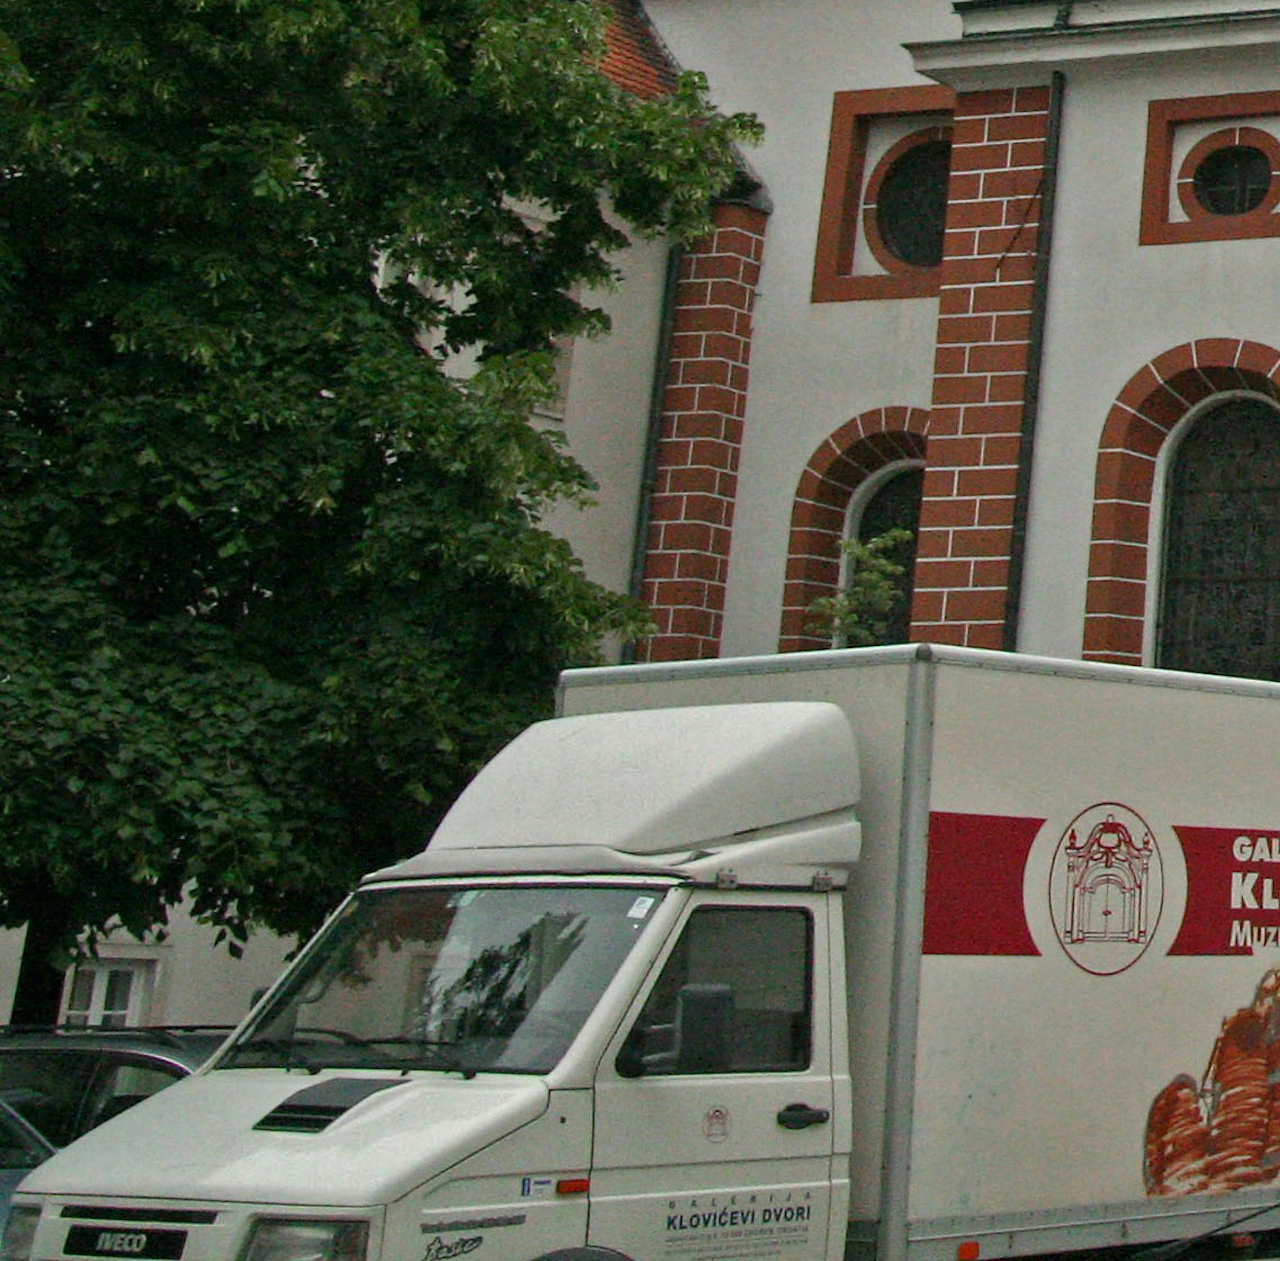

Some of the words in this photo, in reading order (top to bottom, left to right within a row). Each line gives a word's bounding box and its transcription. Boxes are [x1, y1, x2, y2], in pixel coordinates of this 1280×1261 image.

[669, 1192, 812, 1209] GALERIJA
[667, 1207, 756, 1231] KLOVIĆEVI
[762, 1205, 811, 1224] DVORI
[96, 1232, 147, 1253] IVECO
